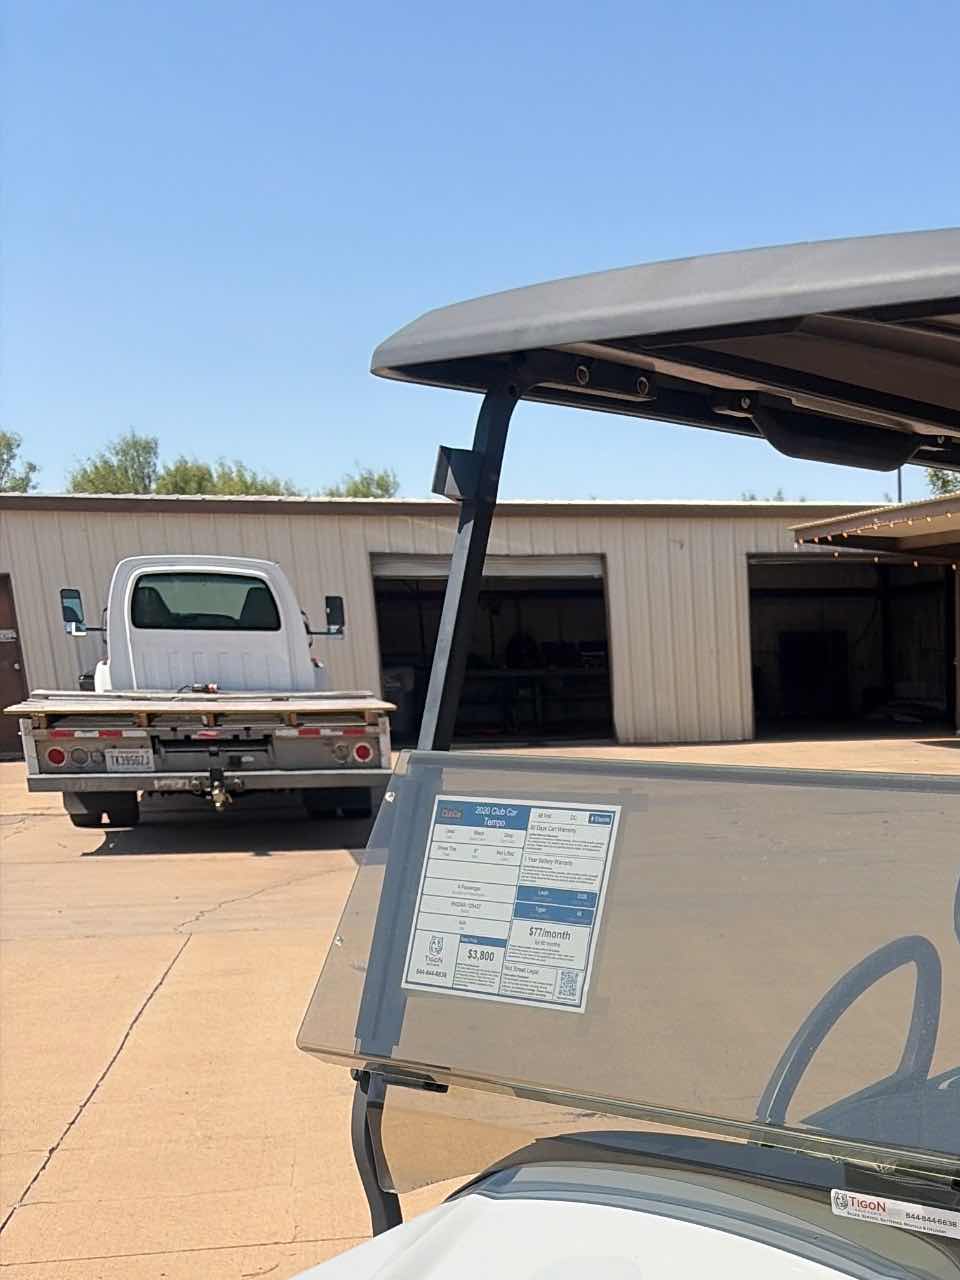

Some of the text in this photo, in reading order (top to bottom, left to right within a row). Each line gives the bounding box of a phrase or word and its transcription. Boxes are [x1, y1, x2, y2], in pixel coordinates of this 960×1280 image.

[491, 807, 505, 816] Club
[506, 808, 518, 817] Car
[484, 817, 506, 827] Tempo
[529, 926, 571, 941] $77/month
[467, 949, 495, 962] $3,800
[849, 1196, 887, 1212] TIGON
